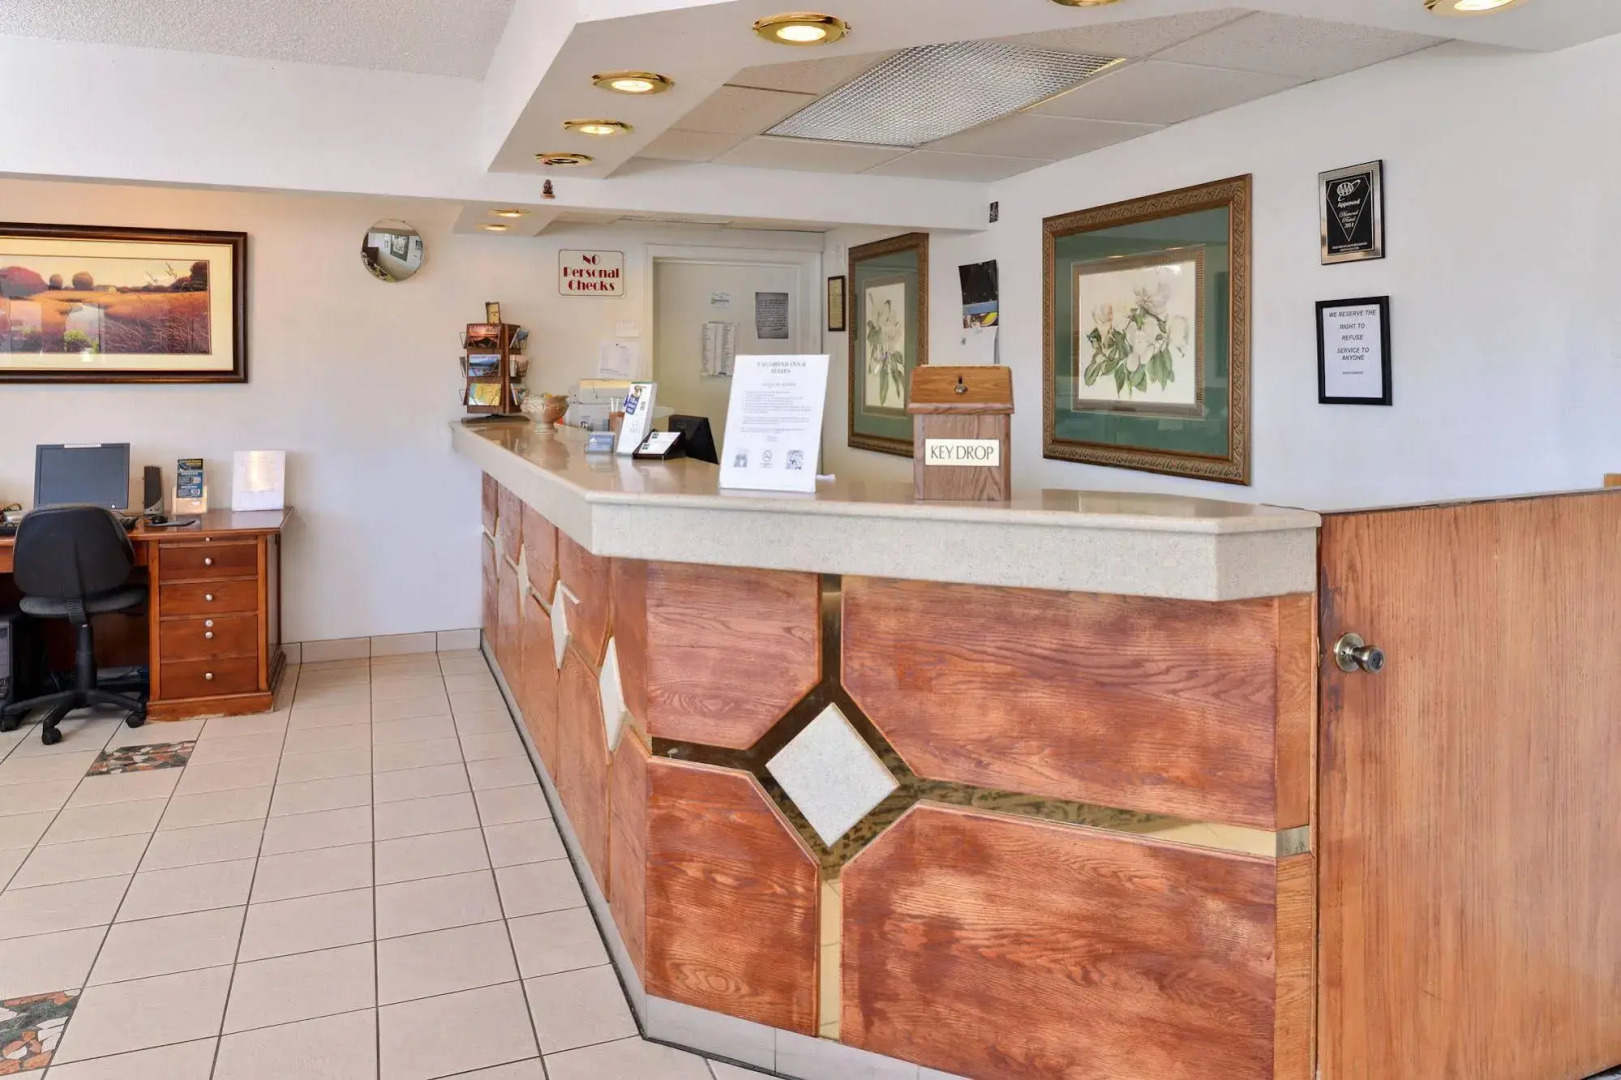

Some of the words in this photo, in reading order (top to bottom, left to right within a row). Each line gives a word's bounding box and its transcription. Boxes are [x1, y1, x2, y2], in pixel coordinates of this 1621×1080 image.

[1337, 199, 1360, 208] Approved
[582, 254, 600, 265] NO
[563, 266, 619, 278] Personal
[568, 280, 615, 291] Checks
[930, 445, 954, 460] KEY
[956, 445, 994, 460] DROP
